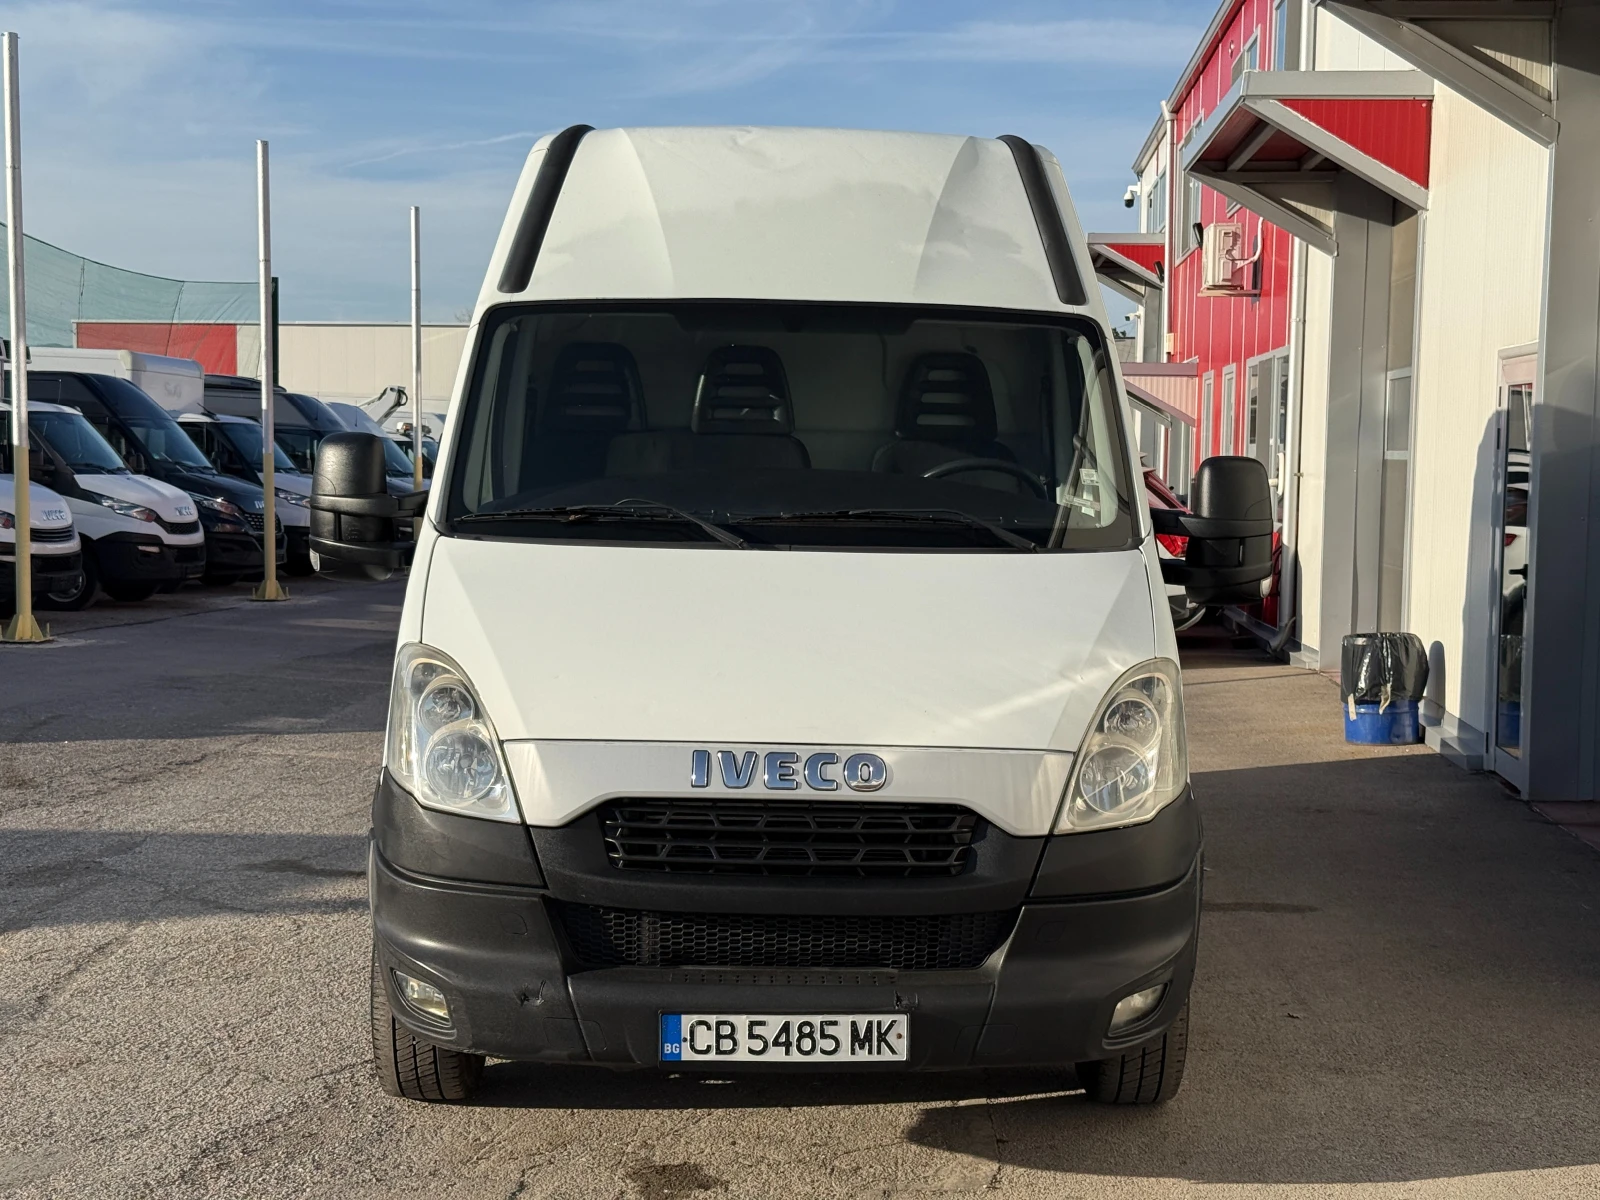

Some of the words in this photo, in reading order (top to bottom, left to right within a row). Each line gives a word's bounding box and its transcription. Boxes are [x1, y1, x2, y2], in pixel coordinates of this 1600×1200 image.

[690, 749, 887, 792] IVECO
[663, 1043, 680, 1054] BG
[688, 1019, 738, 1055] CB
[747, 1020, 839, 1056] 5485
[849, 1020, 898, 1056] MK
